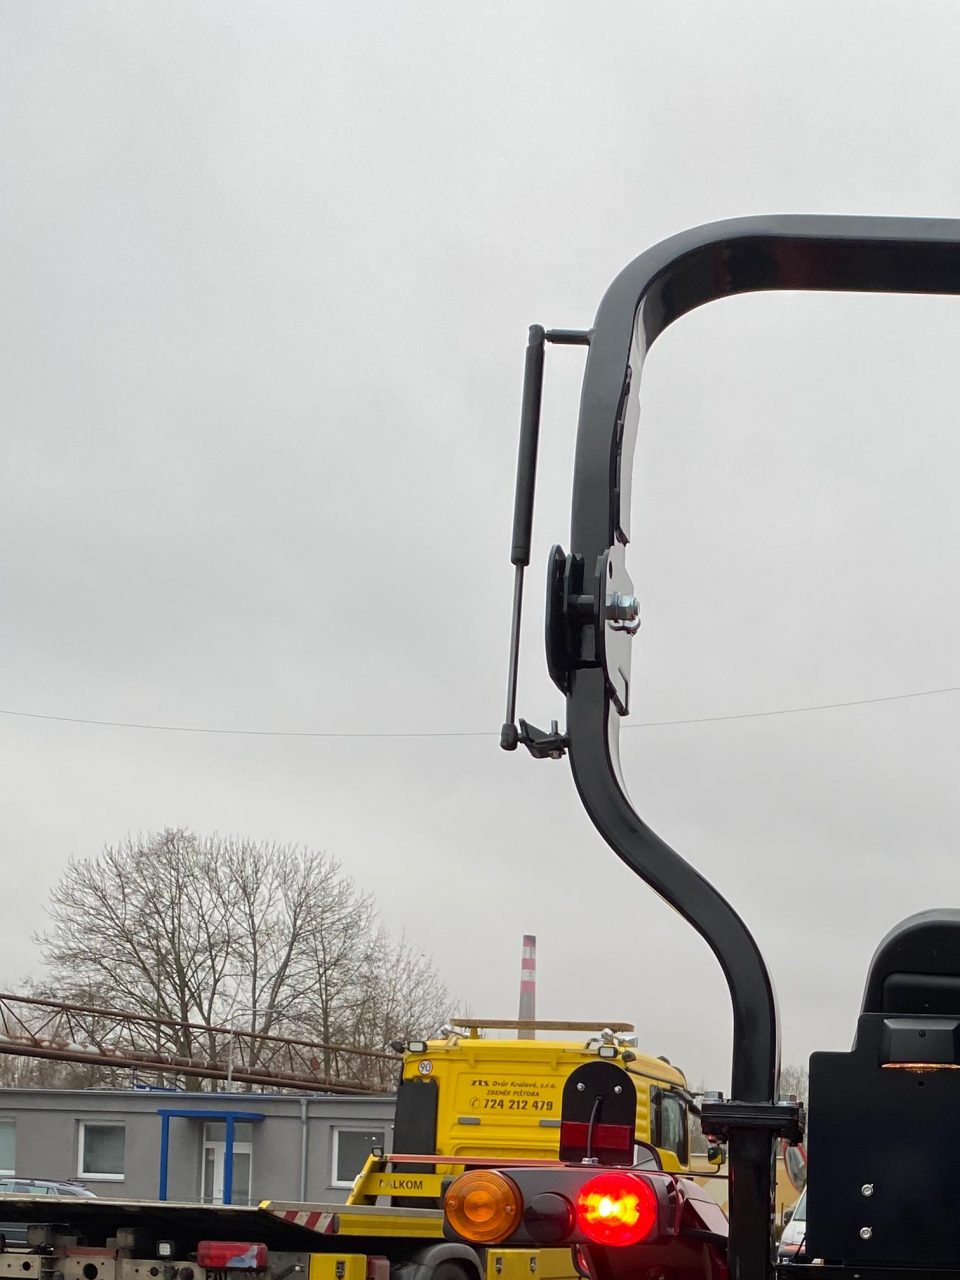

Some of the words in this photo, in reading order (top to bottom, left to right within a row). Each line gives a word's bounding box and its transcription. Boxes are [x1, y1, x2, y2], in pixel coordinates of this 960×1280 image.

[420, 1062, 431, 1073] 90
[483, 1098, 504, 1110] 724
[508, 1099, 528, 1111] 212
[532, 1100, 553, 1111] 479
